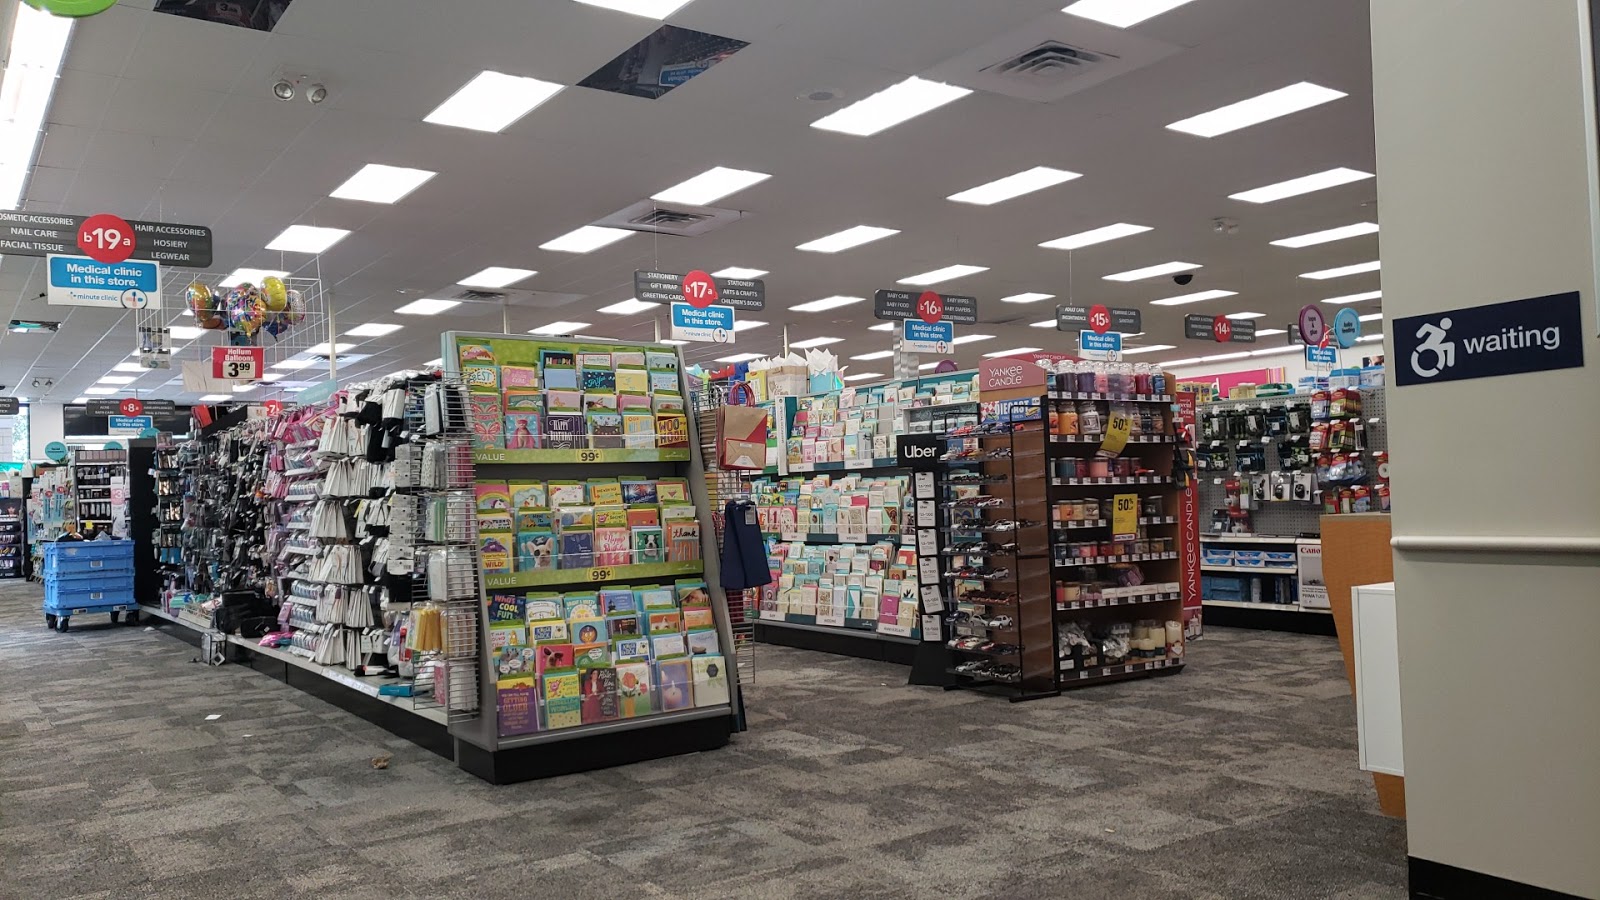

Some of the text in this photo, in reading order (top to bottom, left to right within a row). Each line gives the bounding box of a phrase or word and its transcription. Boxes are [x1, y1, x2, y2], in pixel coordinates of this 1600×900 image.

[0, 213, 74, 226] OSMETIC ACCESSORIES
[10, 227, 58, 238] NAIL CARE
[134, 224, 206, 236] HAIR ACCESSORIES
[1, 240, 64, 252] FACIAL TISSUE
[153, 239, 188, 248] HOSIERY
[151, 252, 190, 261] LEGWEAR
[66, 263, 142, 277] Medical clinic
[71, 274, 138, 287] in this store.
[647, 272, 678, 280] STATIONERY
[77, 292, 118, 302] minute clinic
[682, 308, 724, 318] Medical clinic
[1463, 325, 1560, 354] waiting
[904, 445, 937, 458] Uber
[672, 528, 698, 538] thank
[487, 577, 516, 586] VALUE
[499, 603, 518, 613] COOL
[497, 610, 513, 619] FUN
